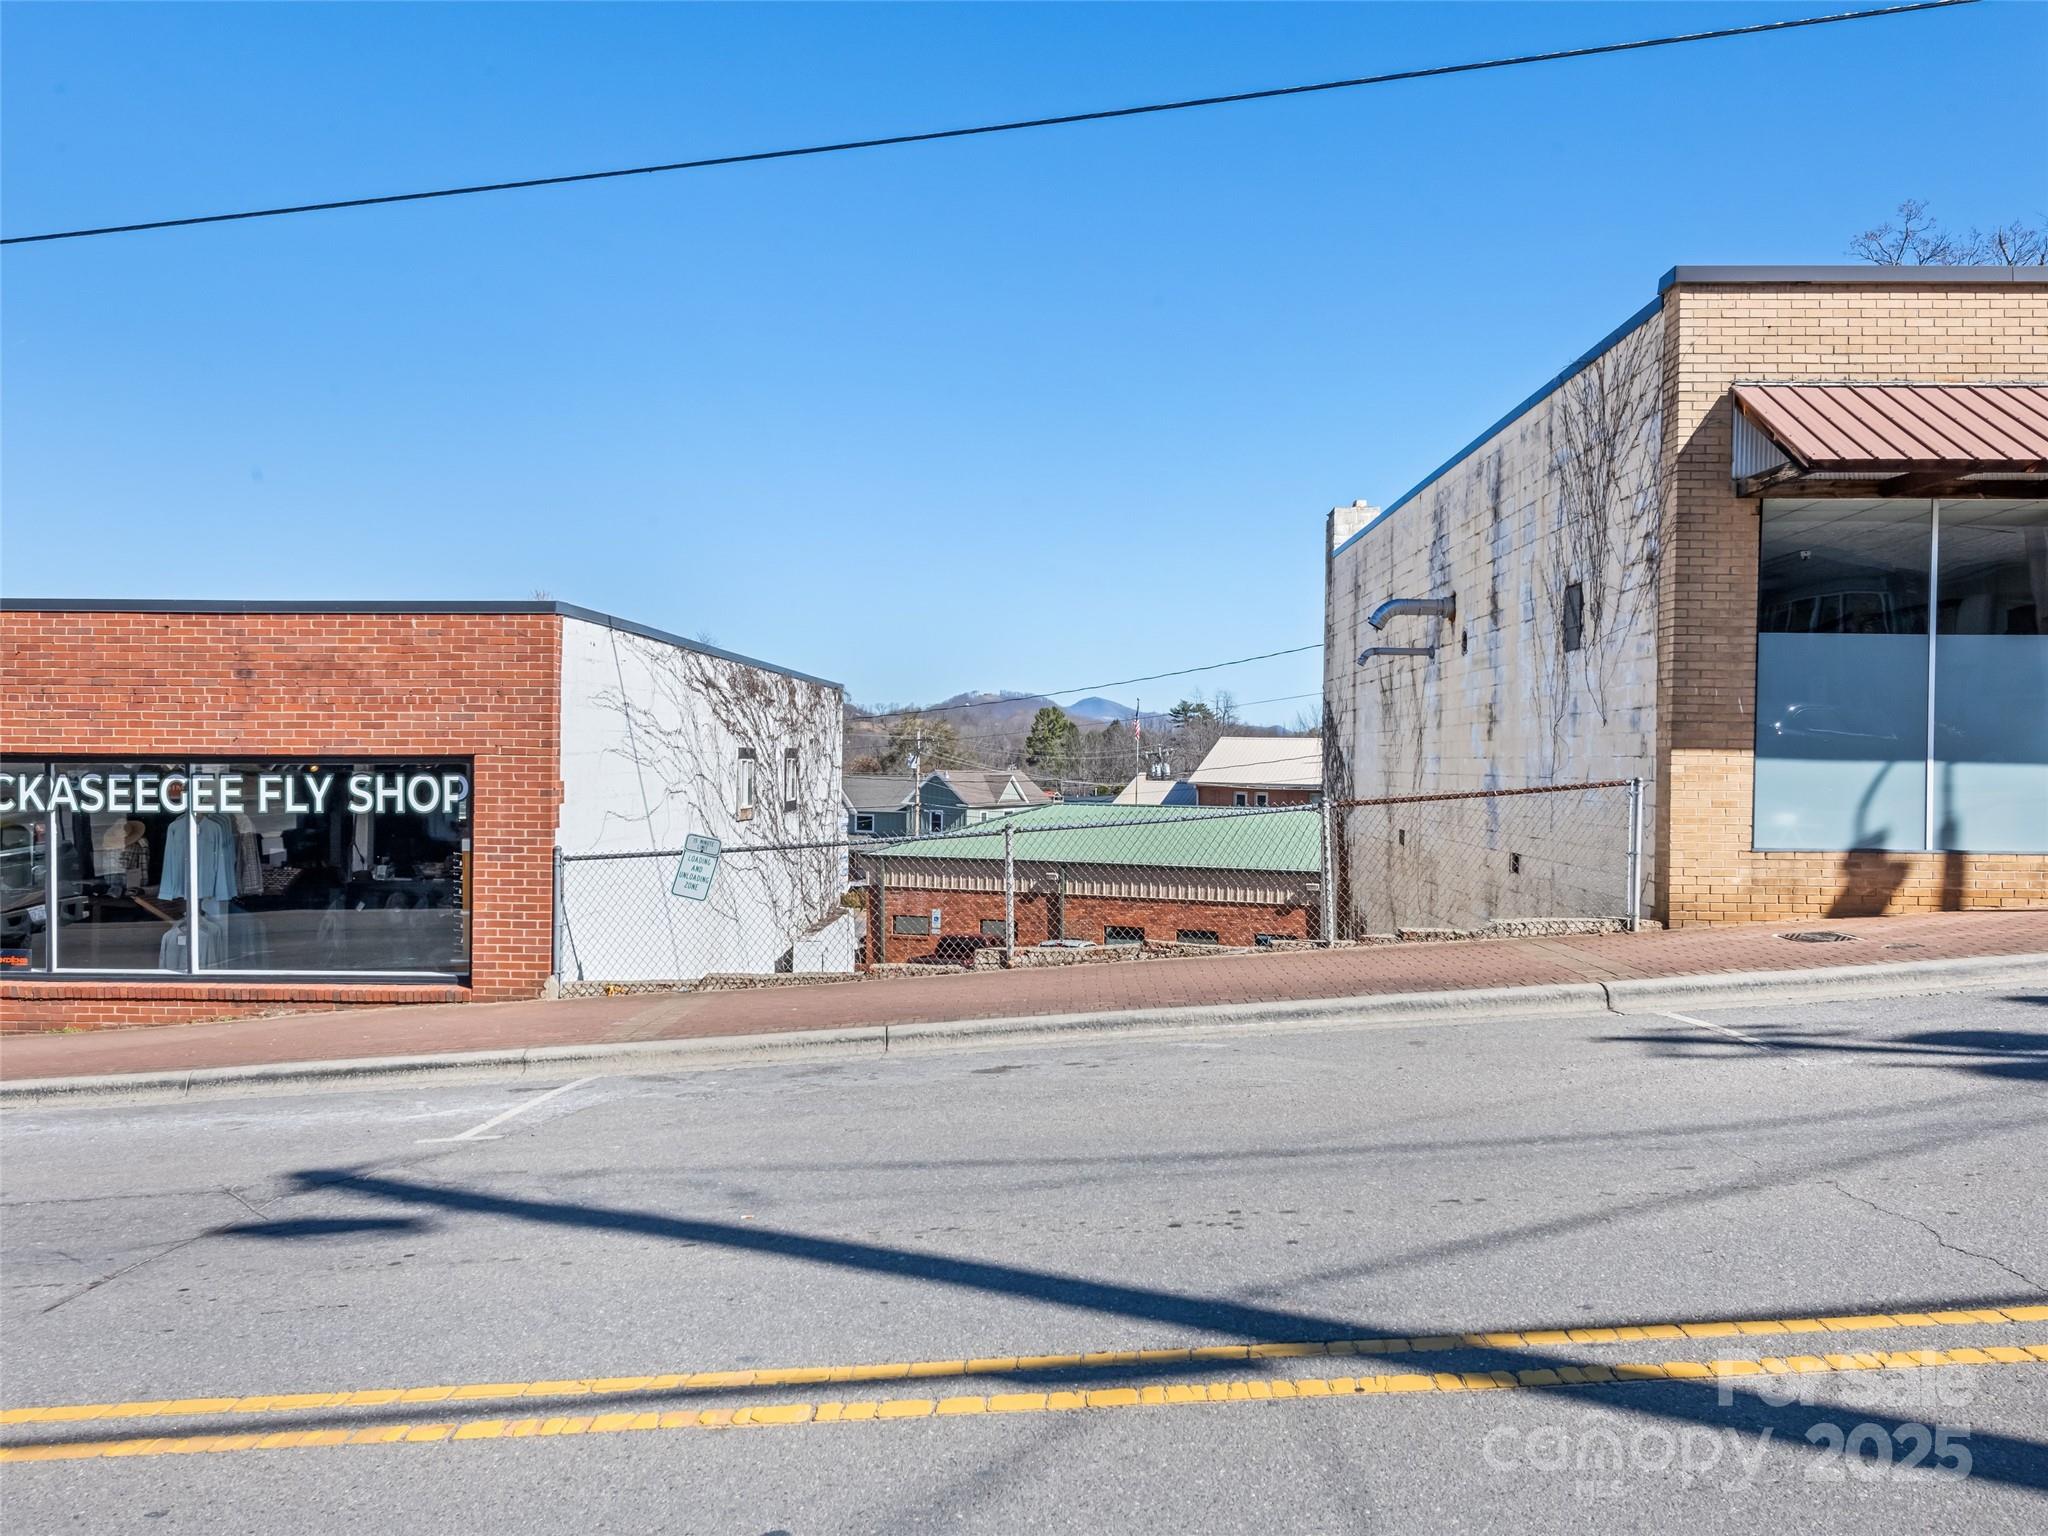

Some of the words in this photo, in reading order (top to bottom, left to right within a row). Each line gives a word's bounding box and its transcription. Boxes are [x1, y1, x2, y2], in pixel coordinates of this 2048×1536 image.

[258, 774, 335, 813] FLY
[348, 773, 468, 814] SHOP
[688, 855, 711, 866] LOADING
[679, 872, 709, 884] UNLOADING
[684, 881, 698, 890] ZONE
